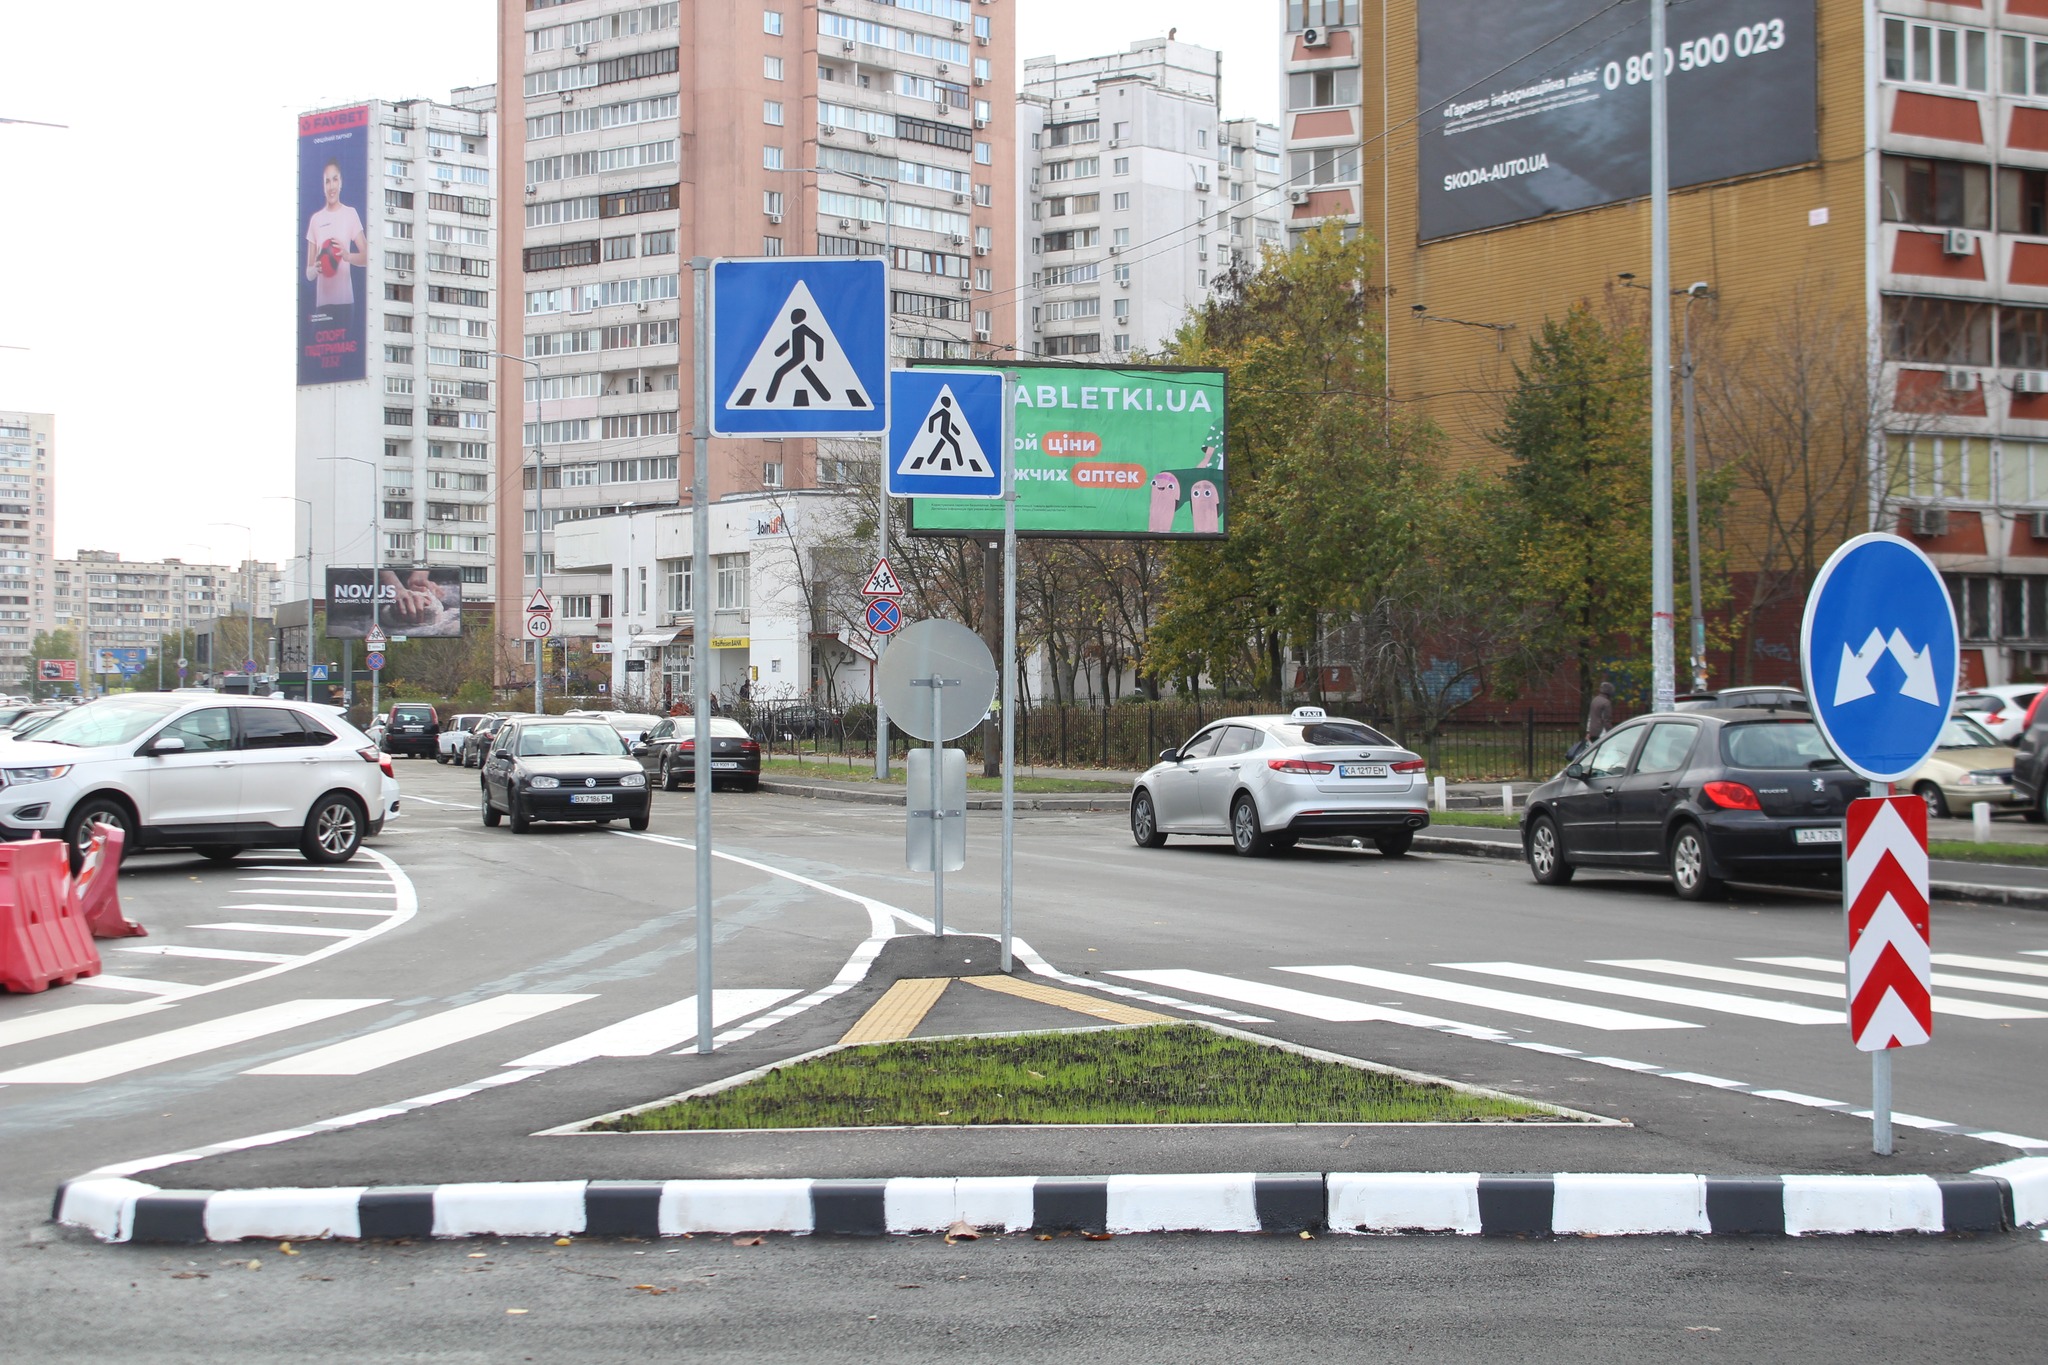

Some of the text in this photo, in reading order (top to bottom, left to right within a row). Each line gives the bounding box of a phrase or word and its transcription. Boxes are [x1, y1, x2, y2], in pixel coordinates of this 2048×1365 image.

[1490, 77, 1566, 108] інформаційна
[1604, 61, 1622, 91] 0
[1679, 32, 1730, 72] 500
[1734, 17, 1786, 58] 023
[313, 109, 365, 129] FAVBET
[1443, 153, 1550, 192] SKODA-AUTO.UA
[1014, 385, 1212, 413] ABLETKI.UA
[1014, 433, 1096, 454] ой ціни
[1014, 468, 1139, 484] жчих аптек
[334, 584, 397, 599] NOVUS
[531, 621, 547, 631] 40
[1344, 766, 1385, 775] KA 1217 EM
[601, 795, 612, 803] EM
[1803, 831, 1816, 841] AA
